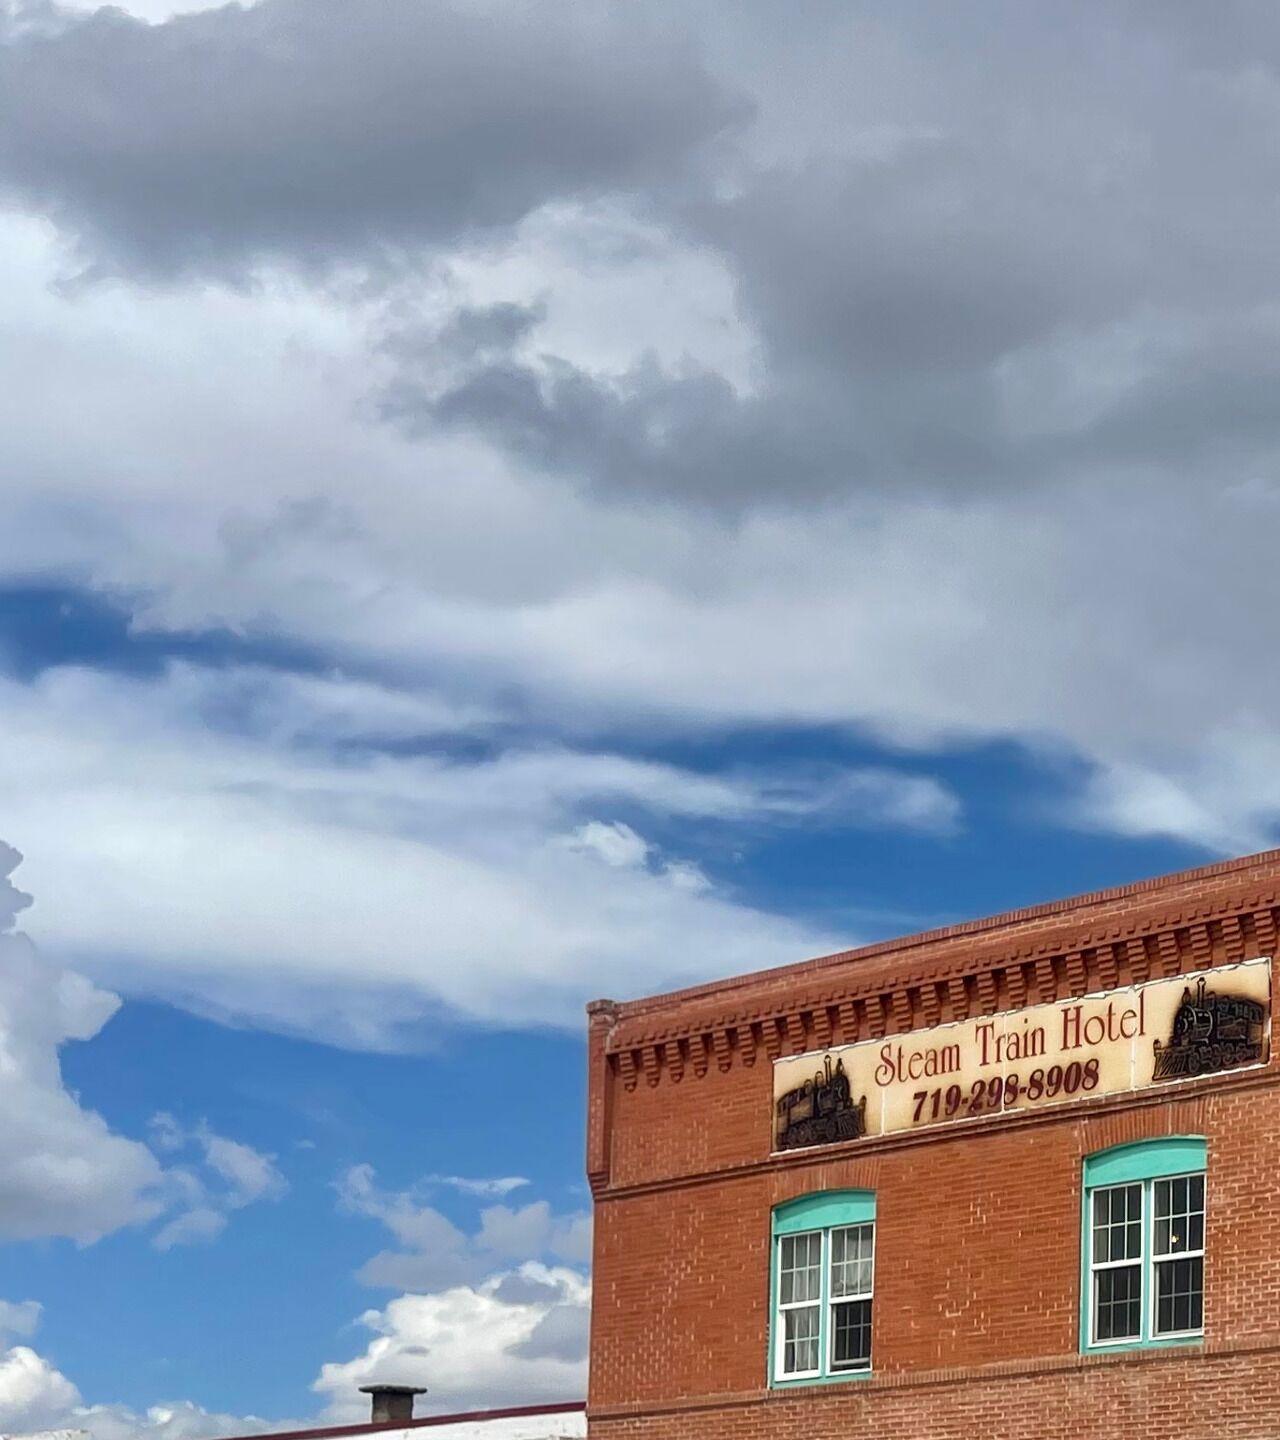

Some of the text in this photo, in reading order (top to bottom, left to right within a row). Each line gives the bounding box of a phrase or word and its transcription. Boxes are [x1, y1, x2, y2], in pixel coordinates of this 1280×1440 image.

[874, 988, 1148, 1087] Steam Train Hotel
[912, 1058, 1100, 1122] 719-298-8908
